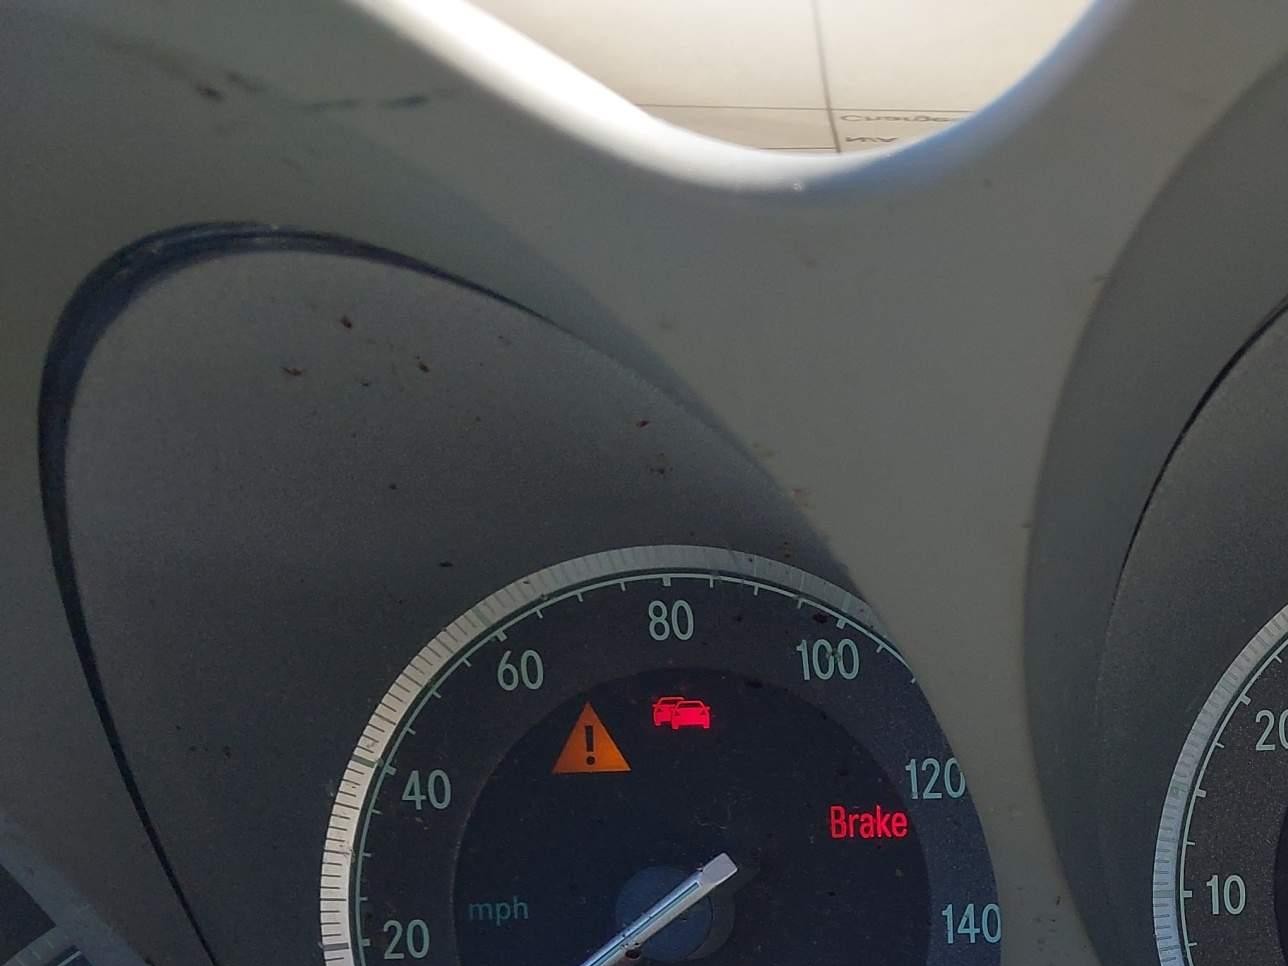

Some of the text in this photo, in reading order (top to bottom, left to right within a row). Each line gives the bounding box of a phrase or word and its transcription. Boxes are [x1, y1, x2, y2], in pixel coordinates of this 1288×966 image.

[648, 599, 695, 641] 80
[496, 649, 545, 692] 60
[796, 638, 861, 682] 100
[401, 769, 452, 811] 40
[905, 757, 967, 800] 120
[829, 805, 909, 840] Brake
[468, 895, 530, 922] mph
[1206, 874, 1247, 916] 10
[382, 919, 431, 961] 20
[941, 903, 1002, 945] 140
